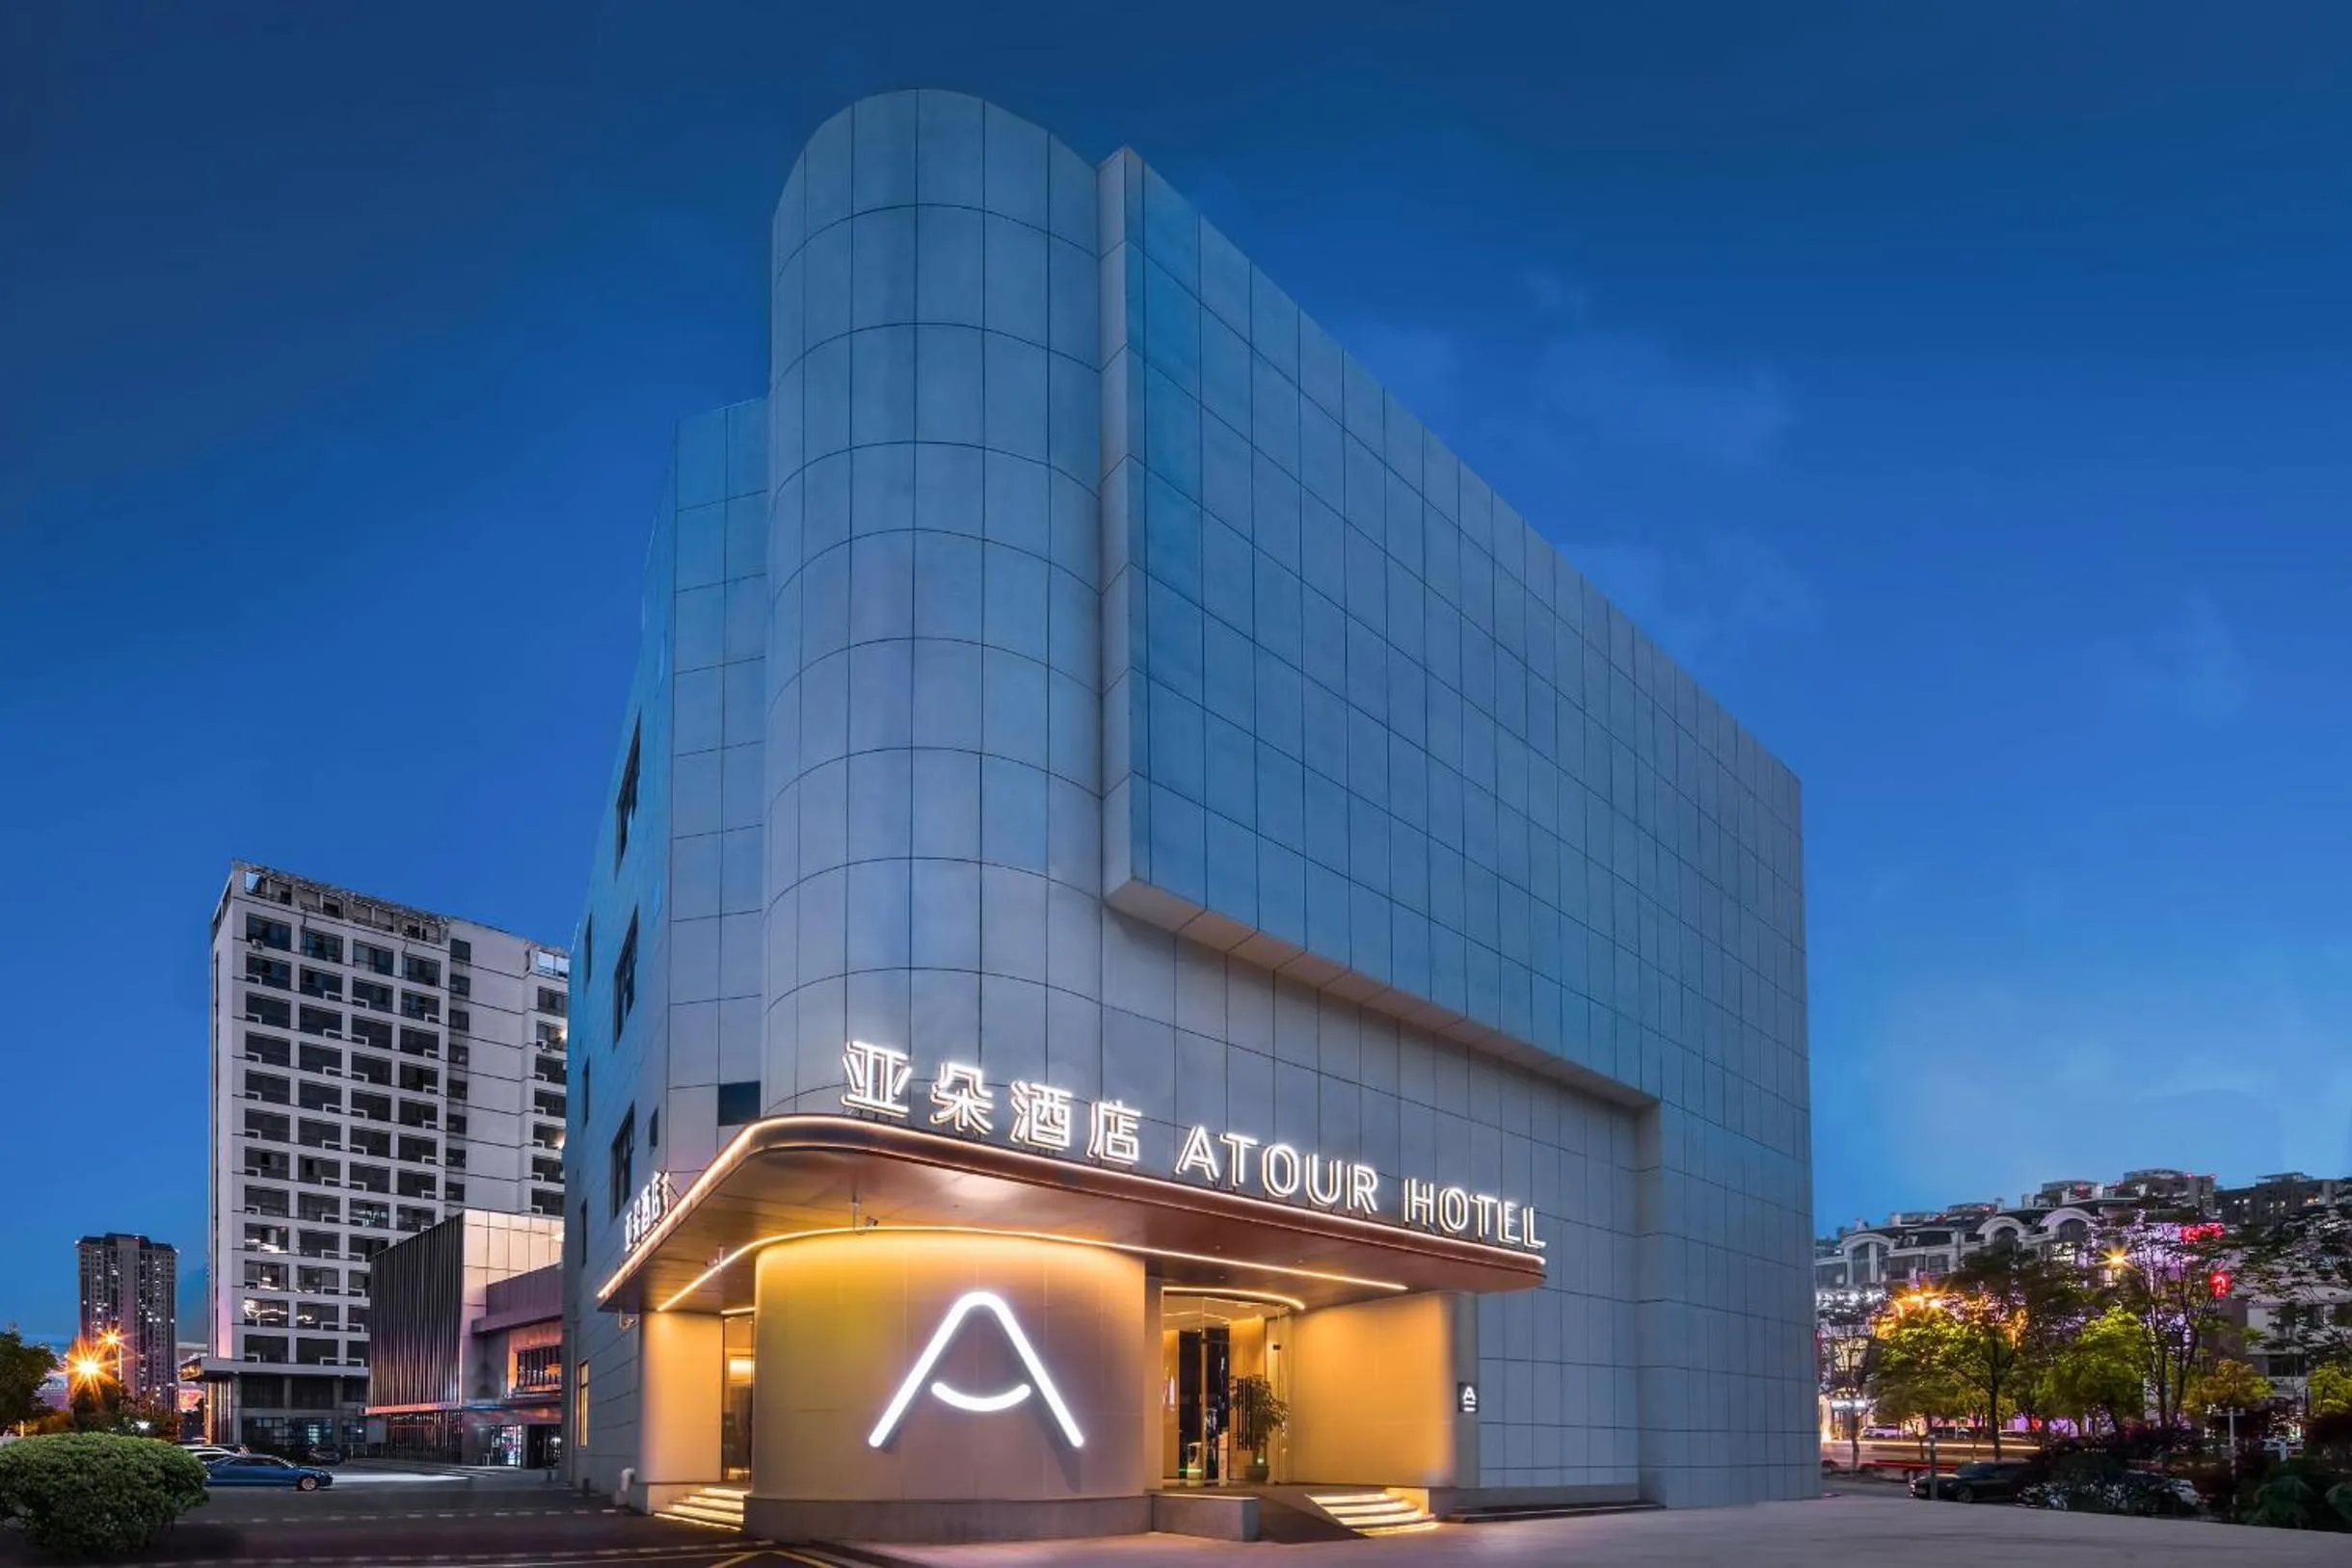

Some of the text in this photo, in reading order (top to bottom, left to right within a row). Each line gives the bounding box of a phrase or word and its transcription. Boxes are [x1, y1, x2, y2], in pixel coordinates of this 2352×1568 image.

[841, 1040, 1546, 1249] 亚朵酒店 ATOUR HOTEL
